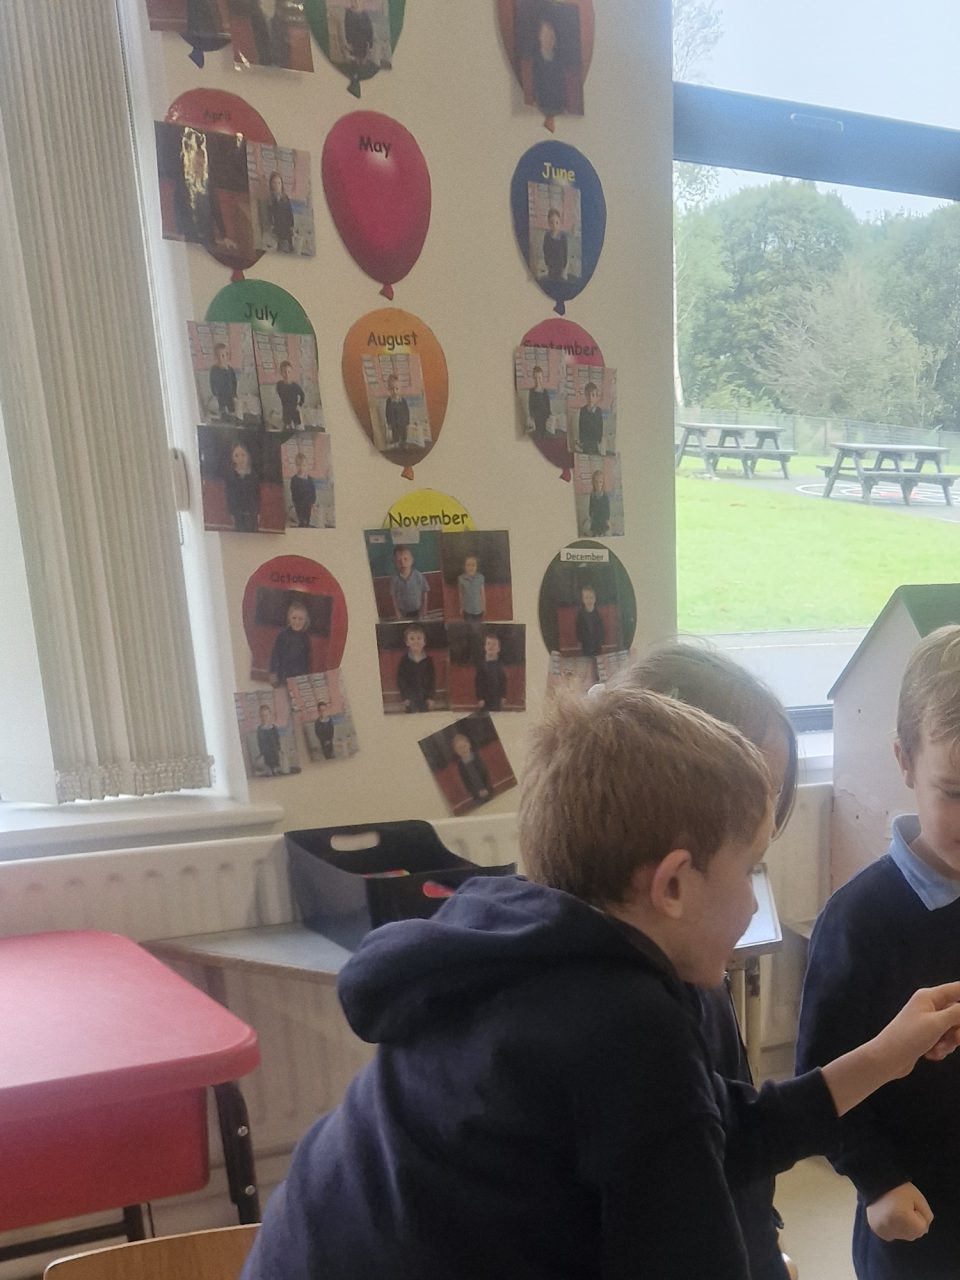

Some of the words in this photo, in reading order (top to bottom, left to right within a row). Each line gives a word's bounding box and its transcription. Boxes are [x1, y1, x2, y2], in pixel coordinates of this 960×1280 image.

[359, 135, 391, 159] May
[541, 161, 576, 181] June
[244, 301, 278, 327] July
[367, 330, 418, 351] August
[388, 509, 468, 528] November
[566, 552, 604, 561] December
[270, 571, 318, 584] October
